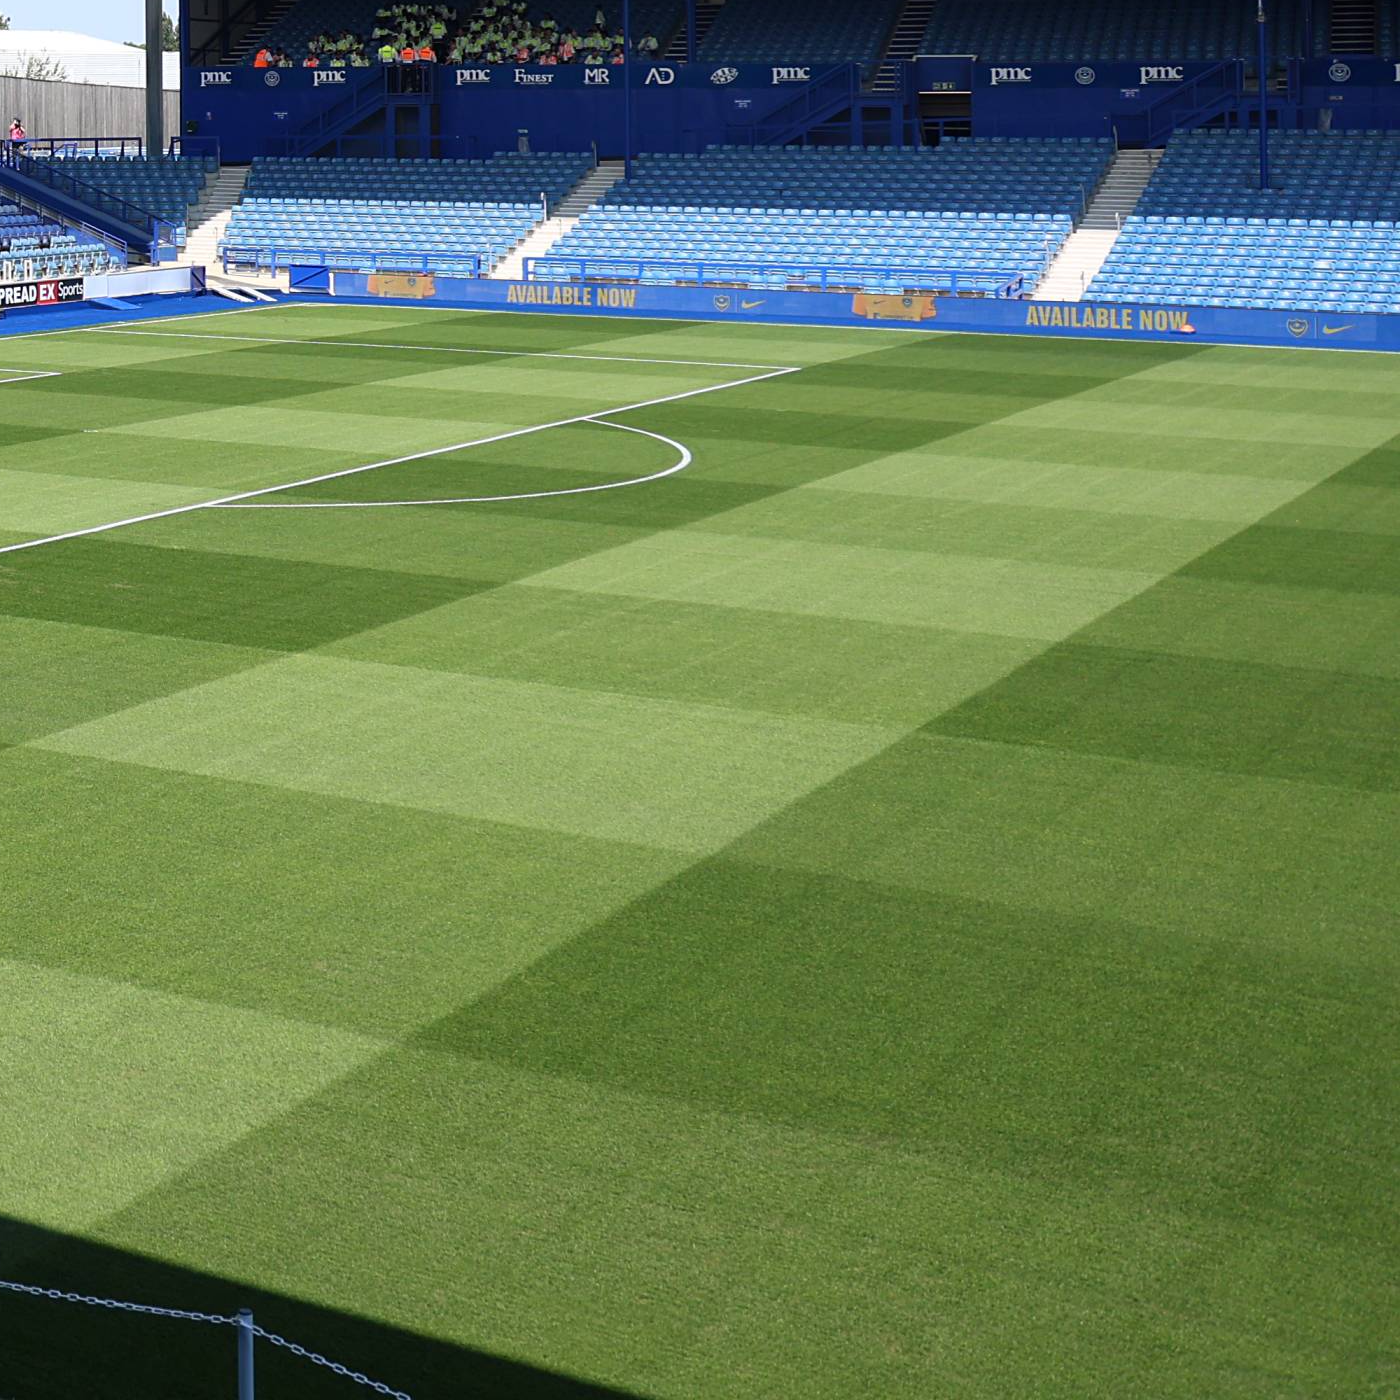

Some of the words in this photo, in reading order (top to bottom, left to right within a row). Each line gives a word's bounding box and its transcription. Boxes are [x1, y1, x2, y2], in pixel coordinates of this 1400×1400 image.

[200, 71, 232, 87] pmc
[313, 70, 346, 86] pmc
[456, 69, 490, 85] pmc
[585, 68, 609, 83] MR
[772, 66, 811, 84] pmc
[991, 66, 1032, 85] pmc
[1140, 65, 1184, 84] pmc
[58, 280, 84, 298] Sports
[507, 284, 591, 306] AVAILABLE
[597, 287, 637, 308] NOW
[1026, 305, 1132, 331] AVAILABLE
[1140, 309, 1188, 332] NOW
